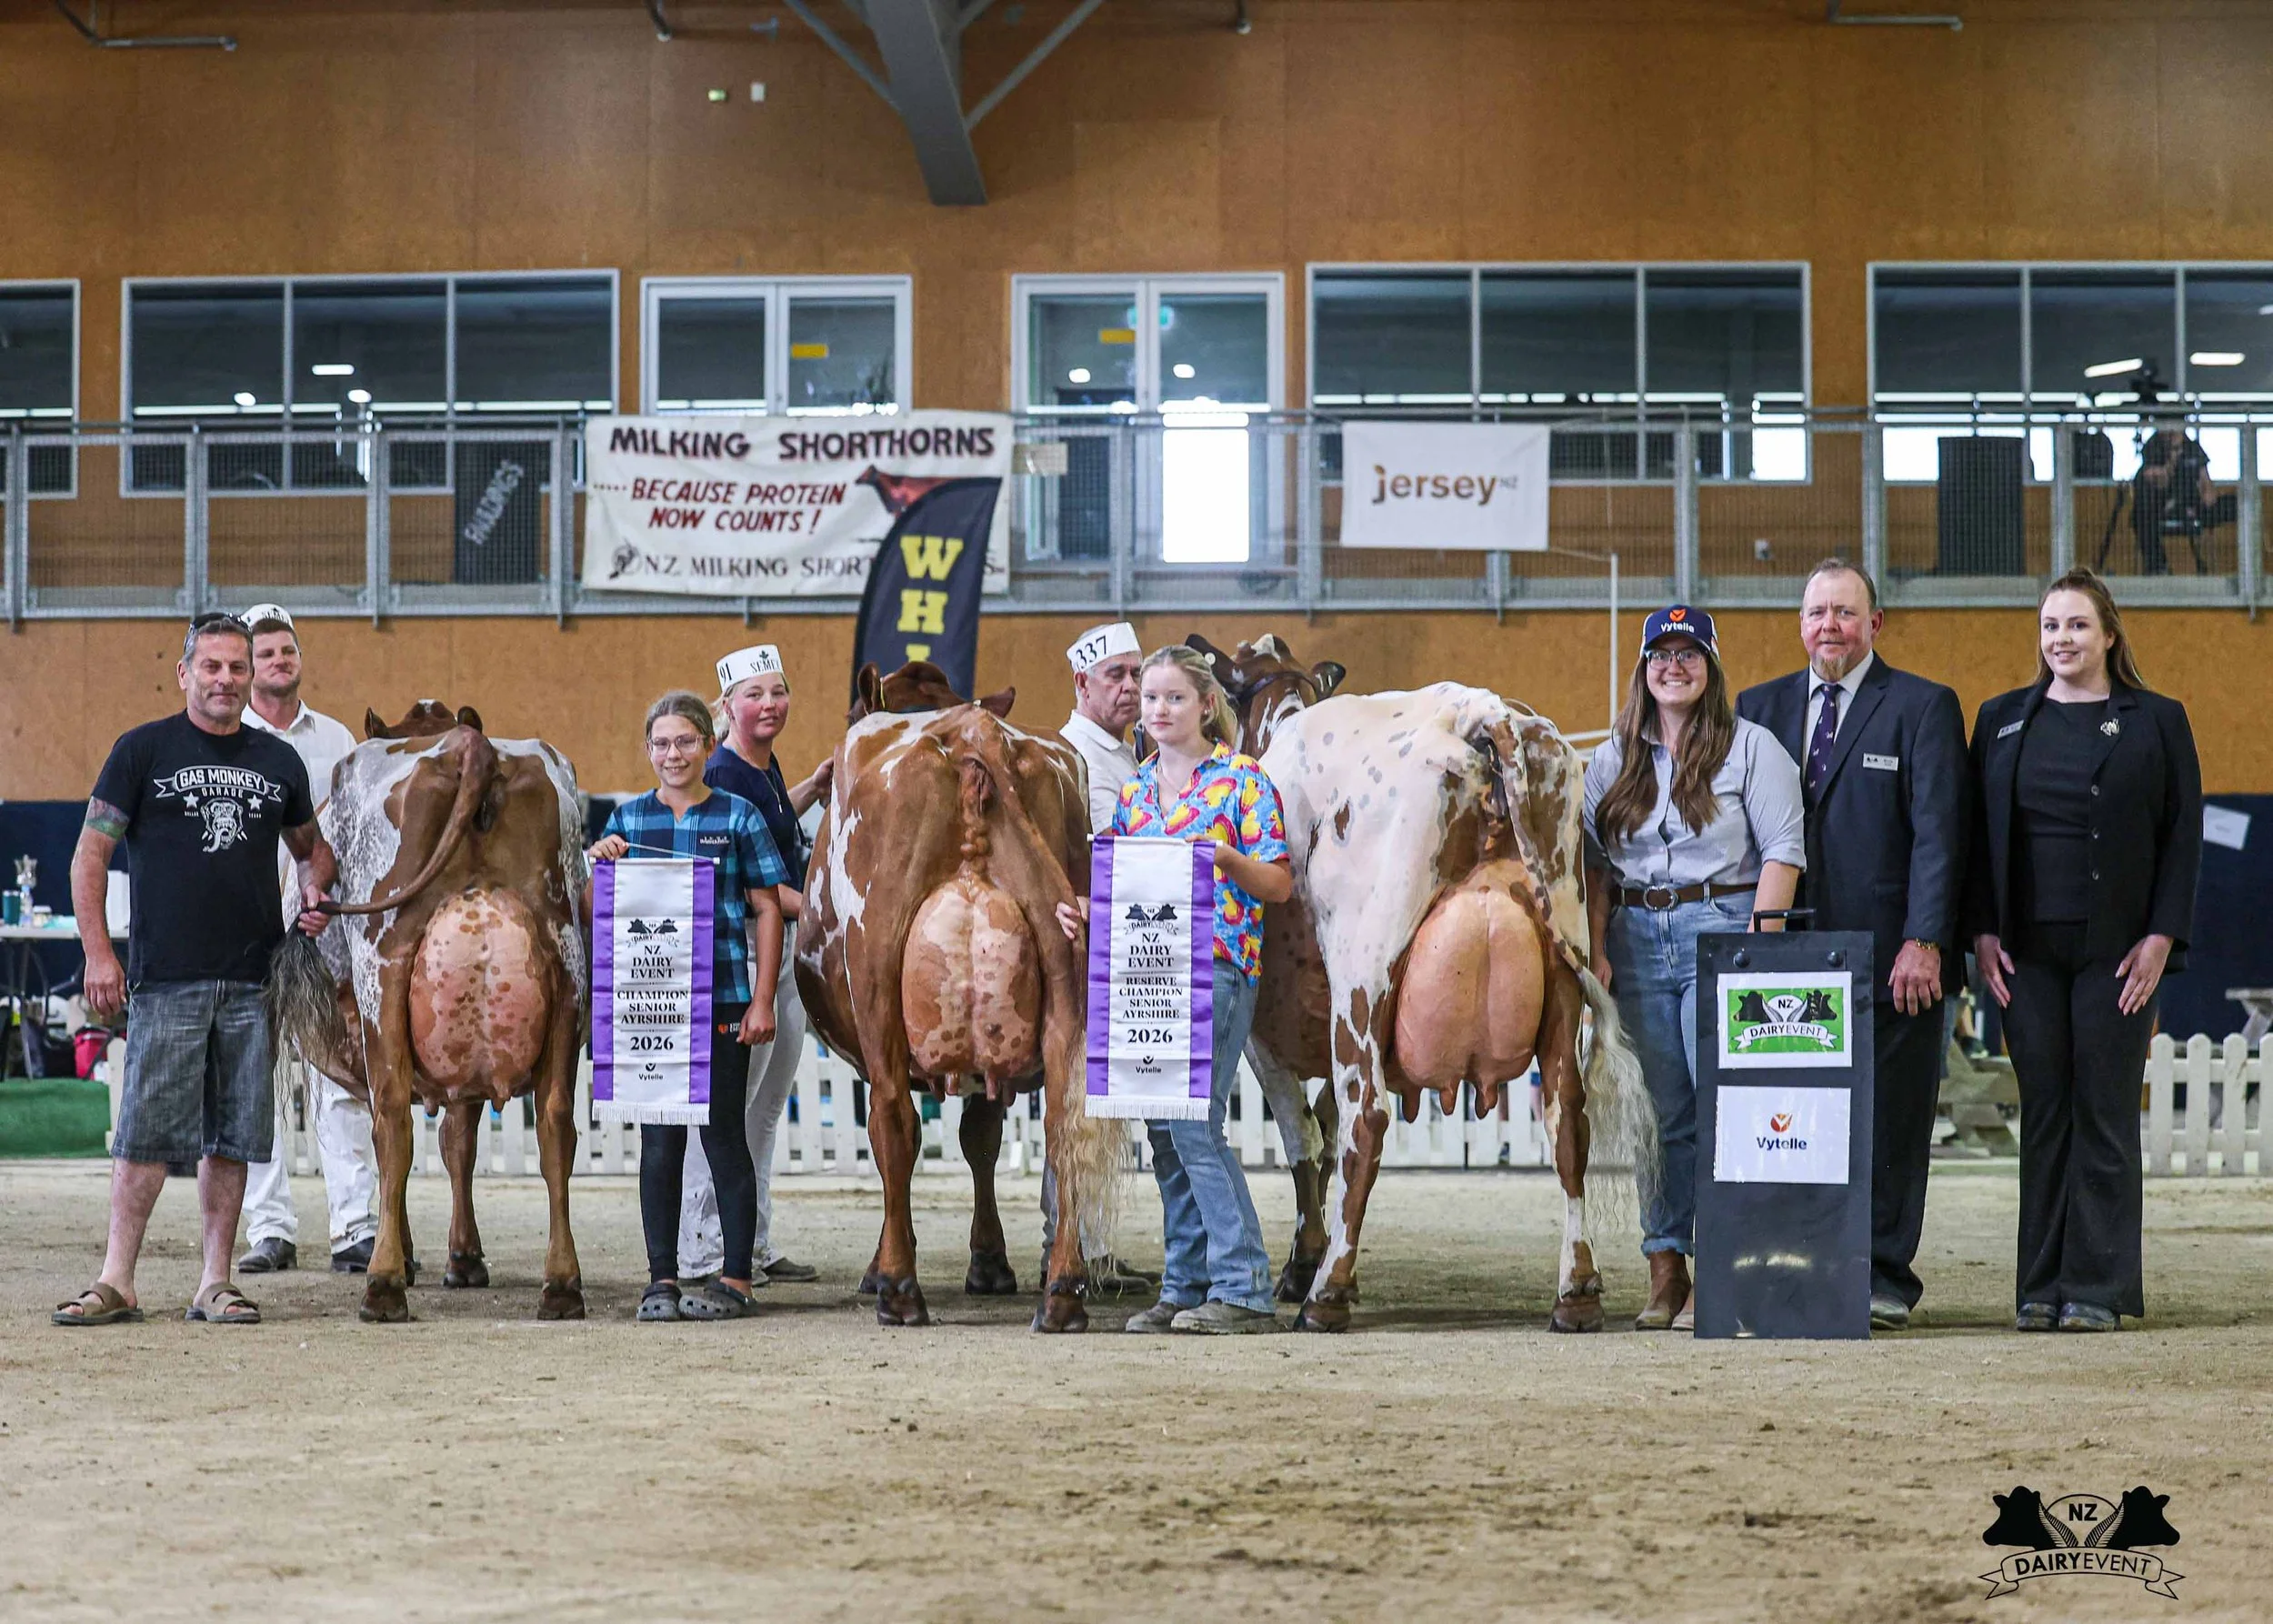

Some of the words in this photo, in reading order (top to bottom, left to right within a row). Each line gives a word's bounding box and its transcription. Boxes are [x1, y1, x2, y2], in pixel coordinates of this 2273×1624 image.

[610, 426, 751, 458] MILKING
[778, 426, 995, 460] SHORTHORNS
[1371, 464, 1497, 506] jersey
[745, 484, 847, 505] PROTEIN
[648, 507, 706, 529] NOW
[645, 555, 680, 575] NZ
[690, 556, 788, 577] MILKING
[1076, 635, 1106, 670] 337
[180, 770, 205, 787] GAS
[208, 768, 261, 789] MONKEY
[201, 787, 243, 798] GARAGE
[1142, 933, 1160, 943] NZ
[644, 945, 661, 955] NZ
[1130, 945, 1172, 955] DAIRY
[633, 957, 673, 967] DAIRY
[1128, 957, 1174, 967] EVENT
[631, 968, 675, 978] EVENT
[1126, 977, 1177, 986] RESERVE
[617, 990, 688, 999] CHAMPION
[1119, 987, 1183, 997] CHAMPION
[629, 1003, 676, 1012] SENIOR
[1129, 999, 1171, 1007] SENIOR
[1777, 999, 1794, 1008] NZ
[1123, 1009, 1179, 1019] AYRSHIRE
[621, 1014, 685, 1025] AYRSHIRE
[1127, 1028, 1173, 1044] 2026
[630, 1036, 674, 1050] 2026
[1136, 1066, 1162, 1075] Vytelle
[1756, 1137, 1807, 1151] Vytelle
